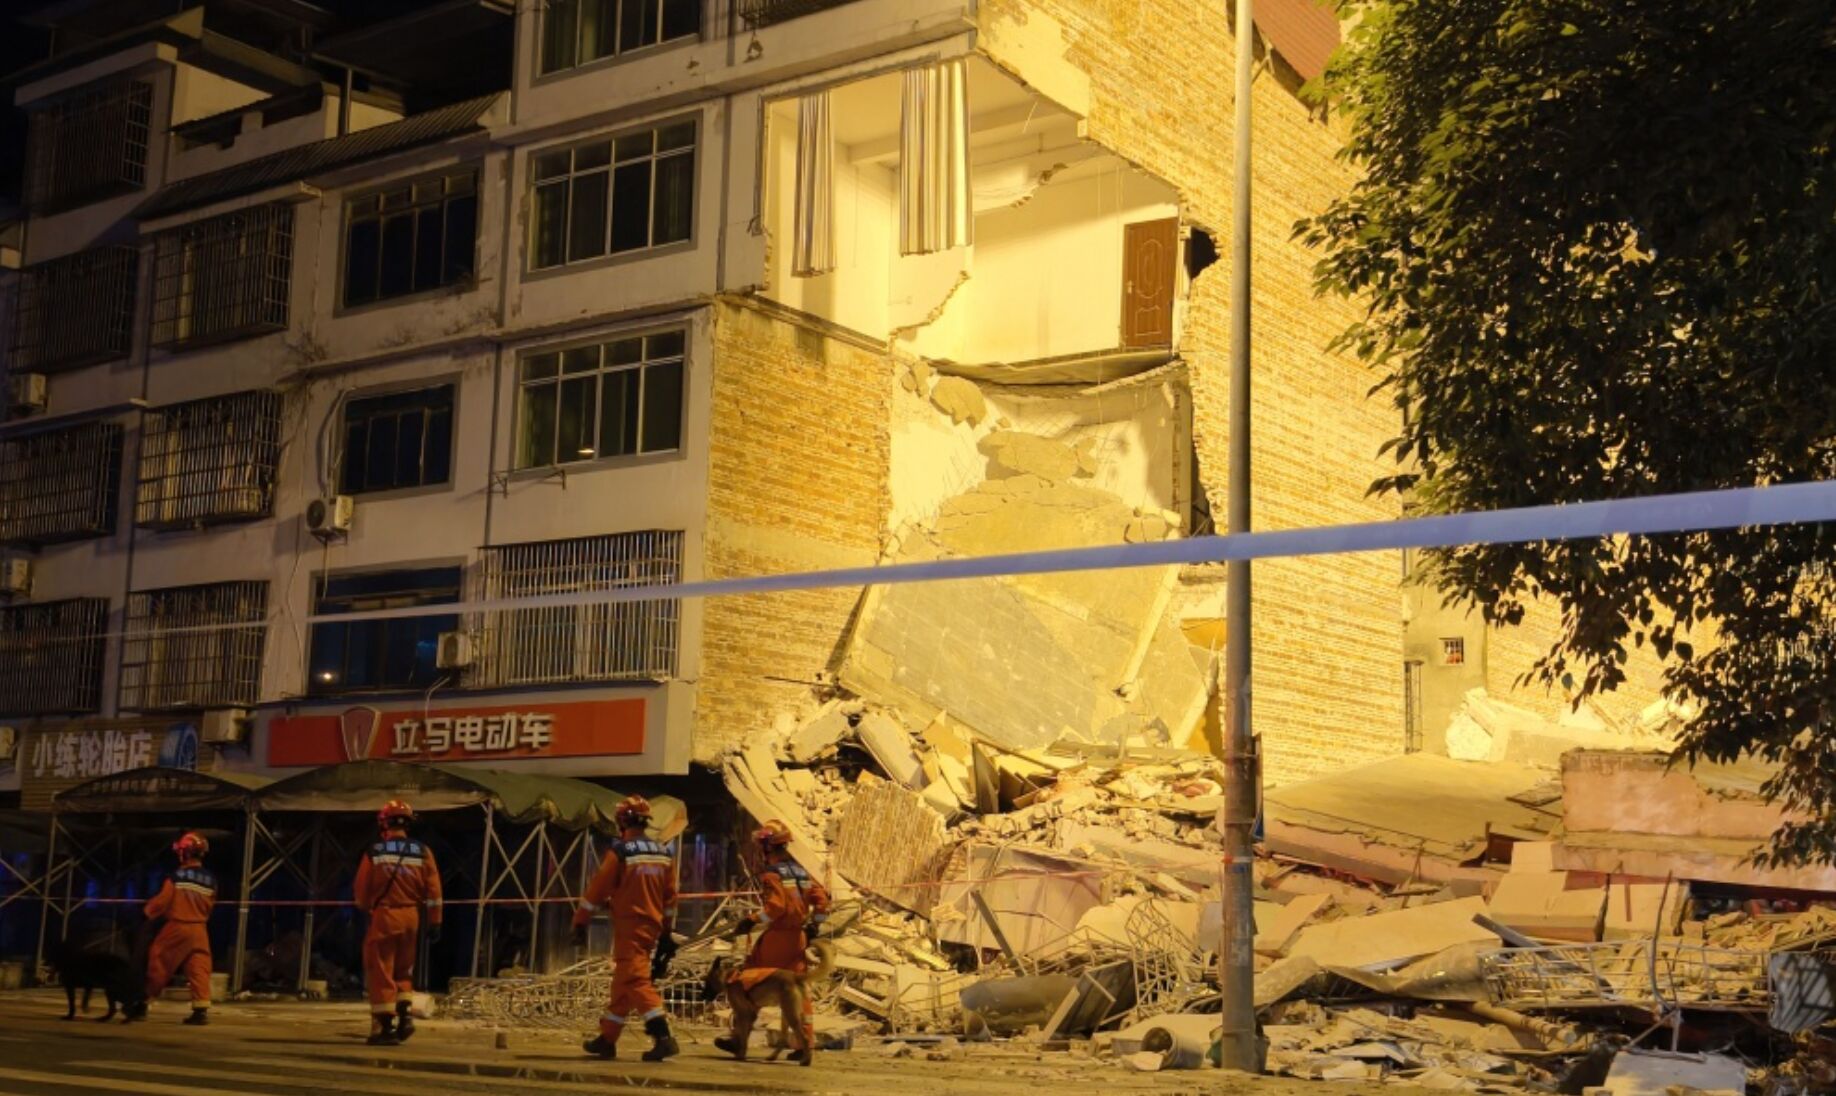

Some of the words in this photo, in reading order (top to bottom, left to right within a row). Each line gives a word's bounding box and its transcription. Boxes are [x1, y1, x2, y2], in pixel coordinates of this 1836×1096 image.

[391, 712, 553, 754] 立马电动车
